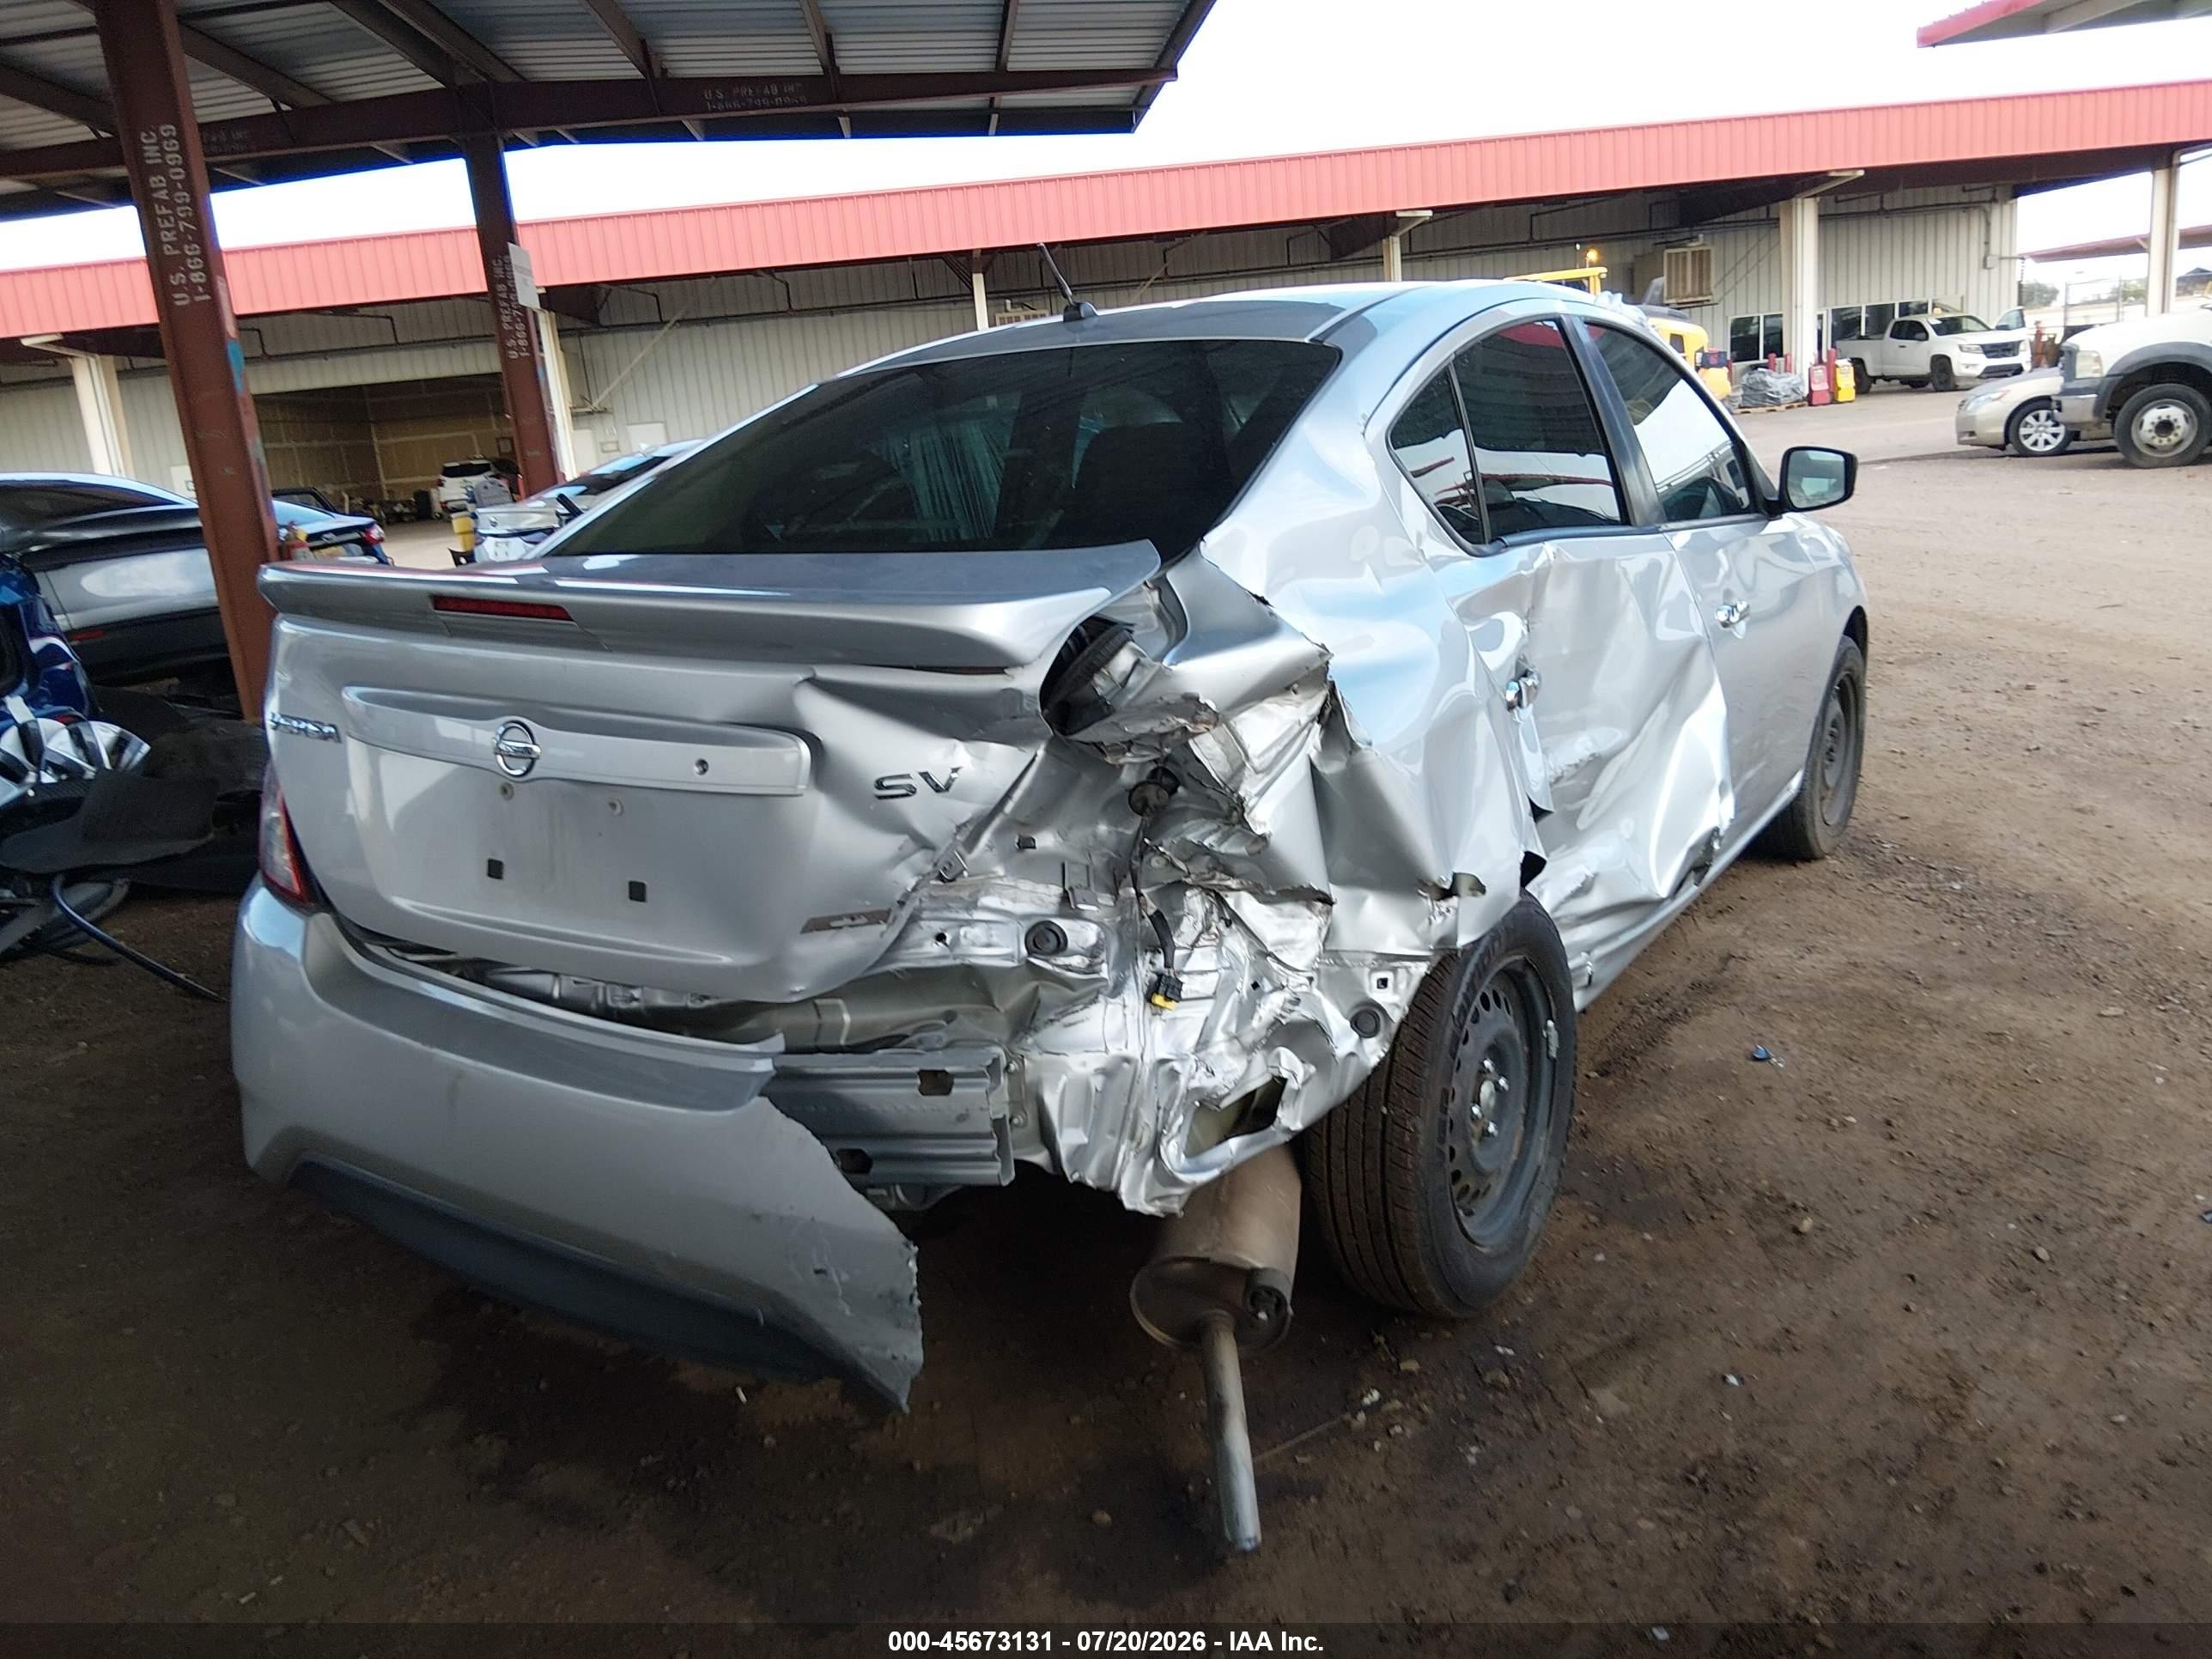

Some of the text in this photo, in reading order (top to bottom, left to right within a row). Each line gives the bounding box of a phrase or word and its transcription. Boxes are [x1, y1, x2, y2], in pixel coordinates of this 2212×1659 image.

[149, 174, 182, 256] PREFAB
[159, 123, 212, 302] 1-866-799-0969
[169, 266, 190, 307] U.S.
[495, 283, 514, 331] PREFAB
[874, 766, 963, 800] SV
